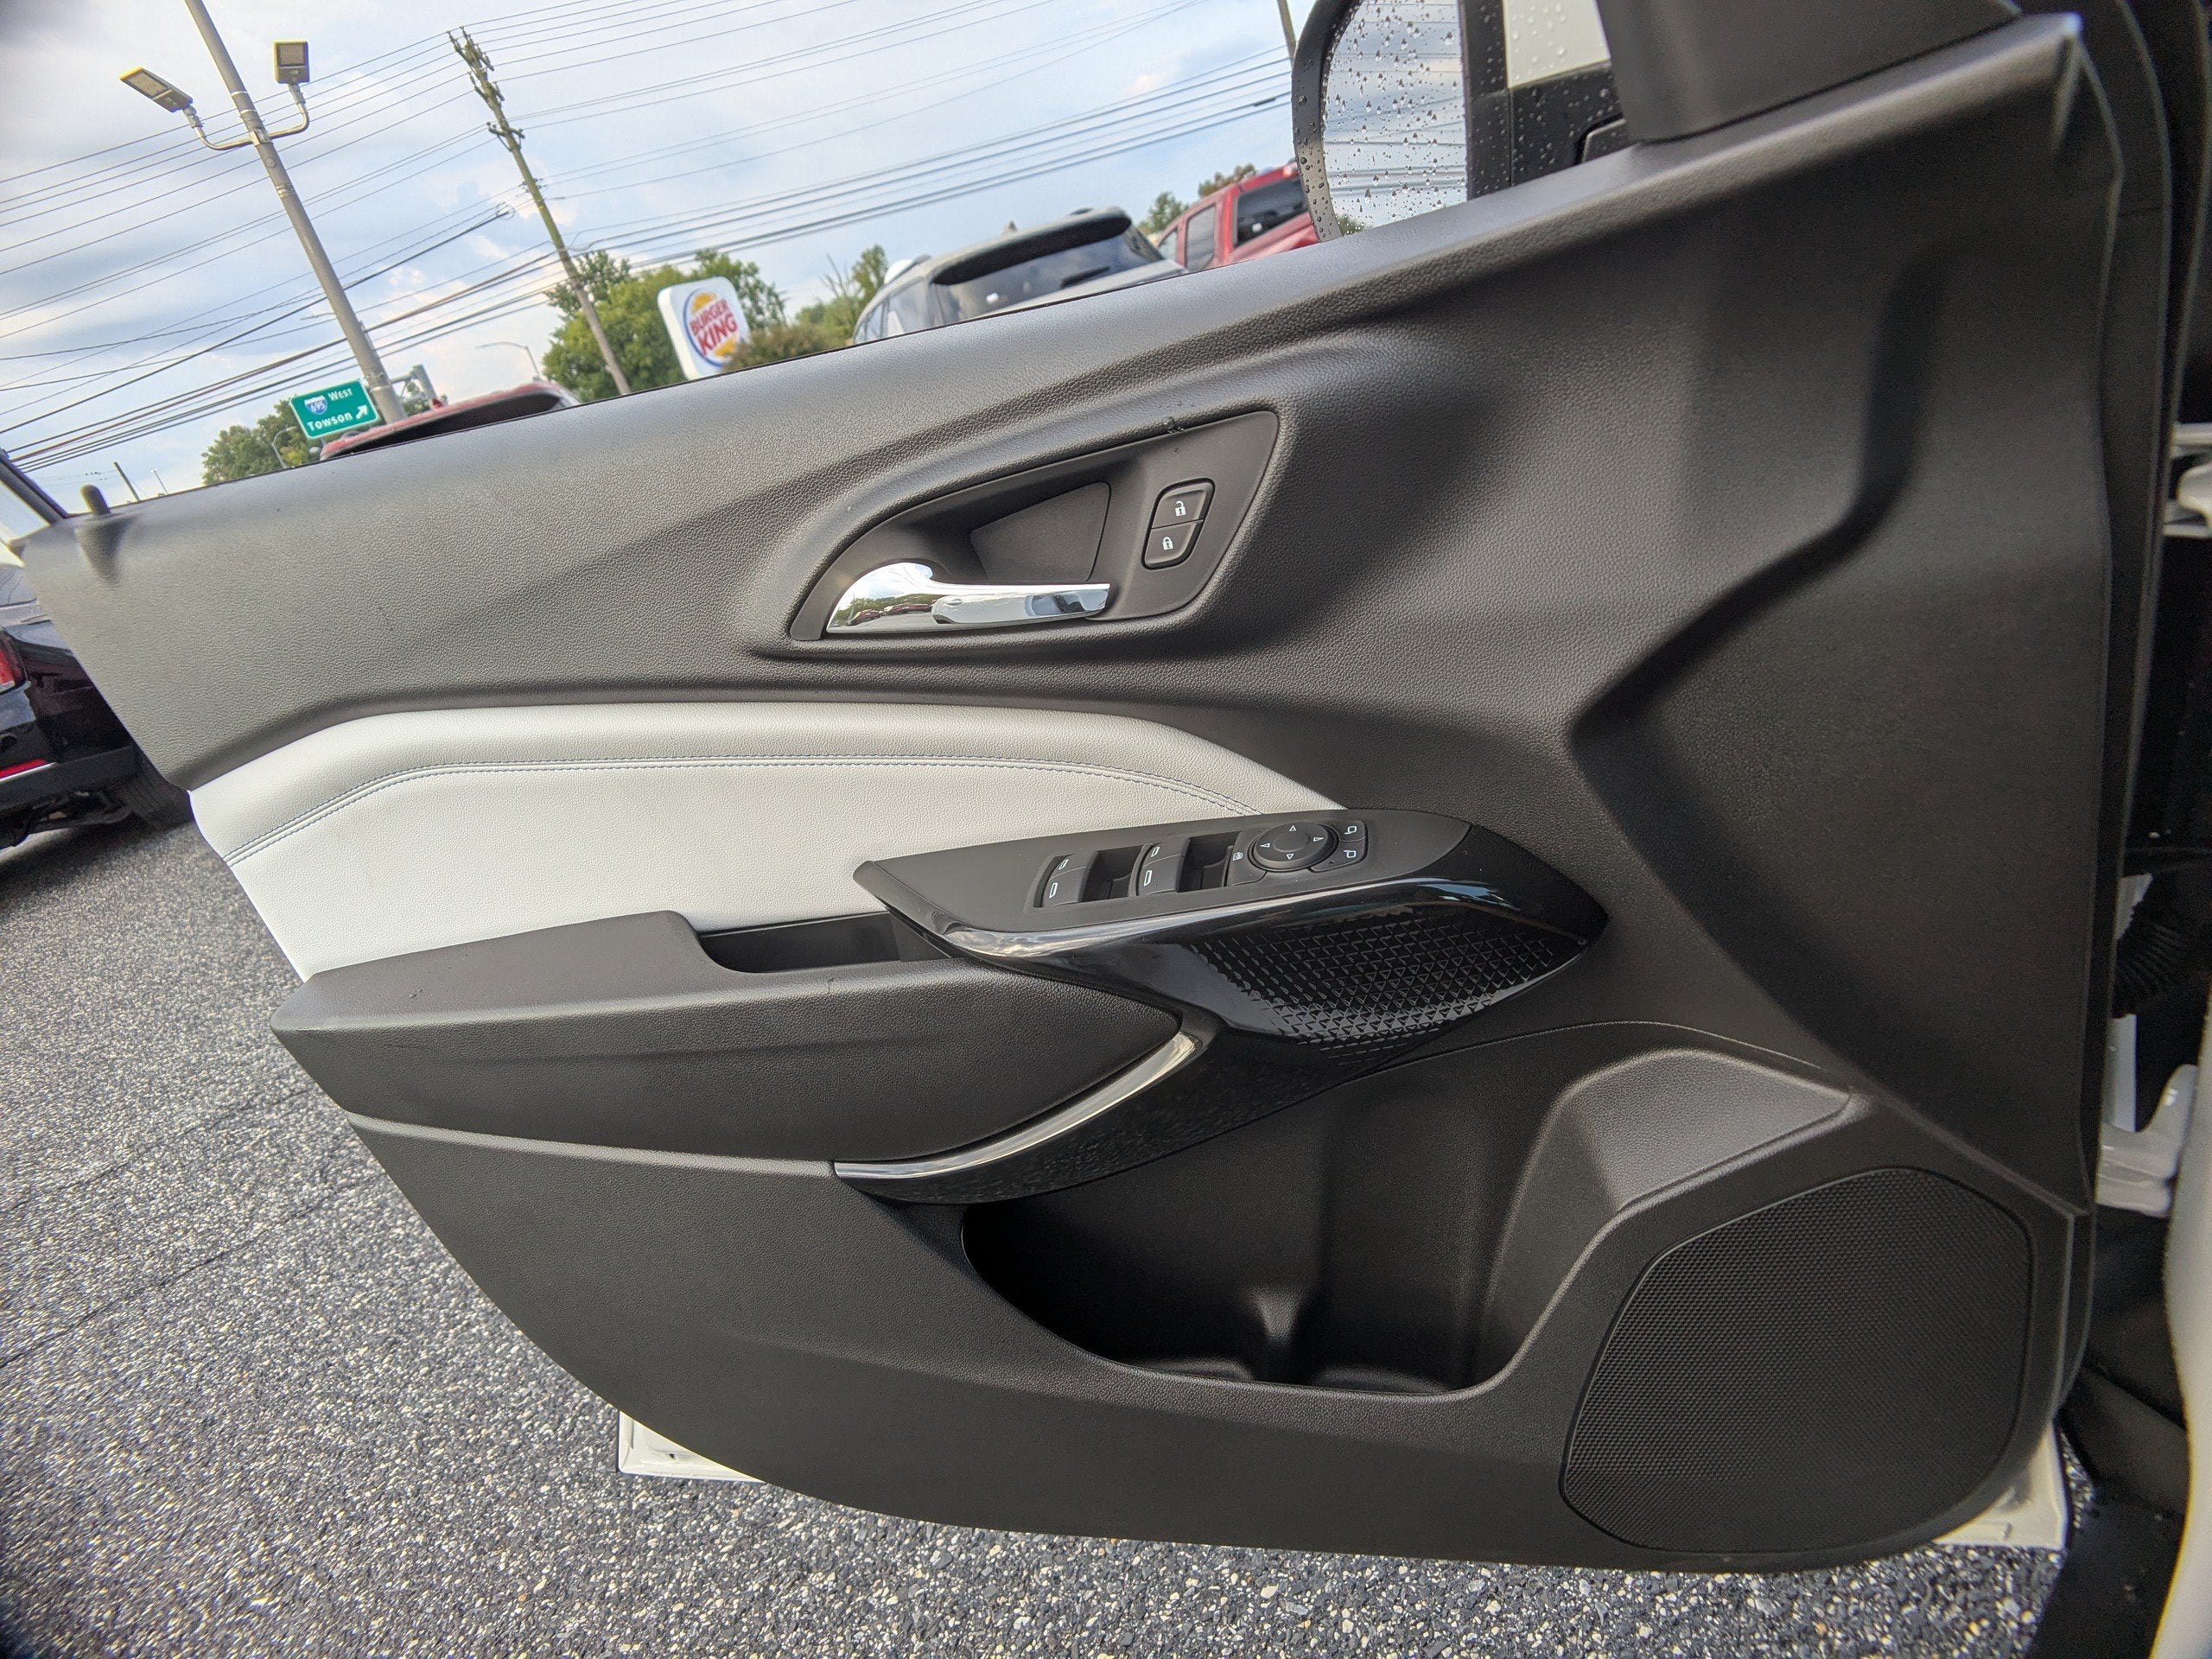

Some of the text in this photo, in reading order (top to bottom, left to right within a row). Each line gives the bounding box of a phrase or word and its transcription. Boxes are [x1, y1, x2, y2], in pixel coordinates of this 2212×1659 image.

[690, 298, 729, 335] BURGER
[698, 312, 738, 357] KING
[310, 400, 326, 411] 695
[307, 412, 353, 431] Towson
